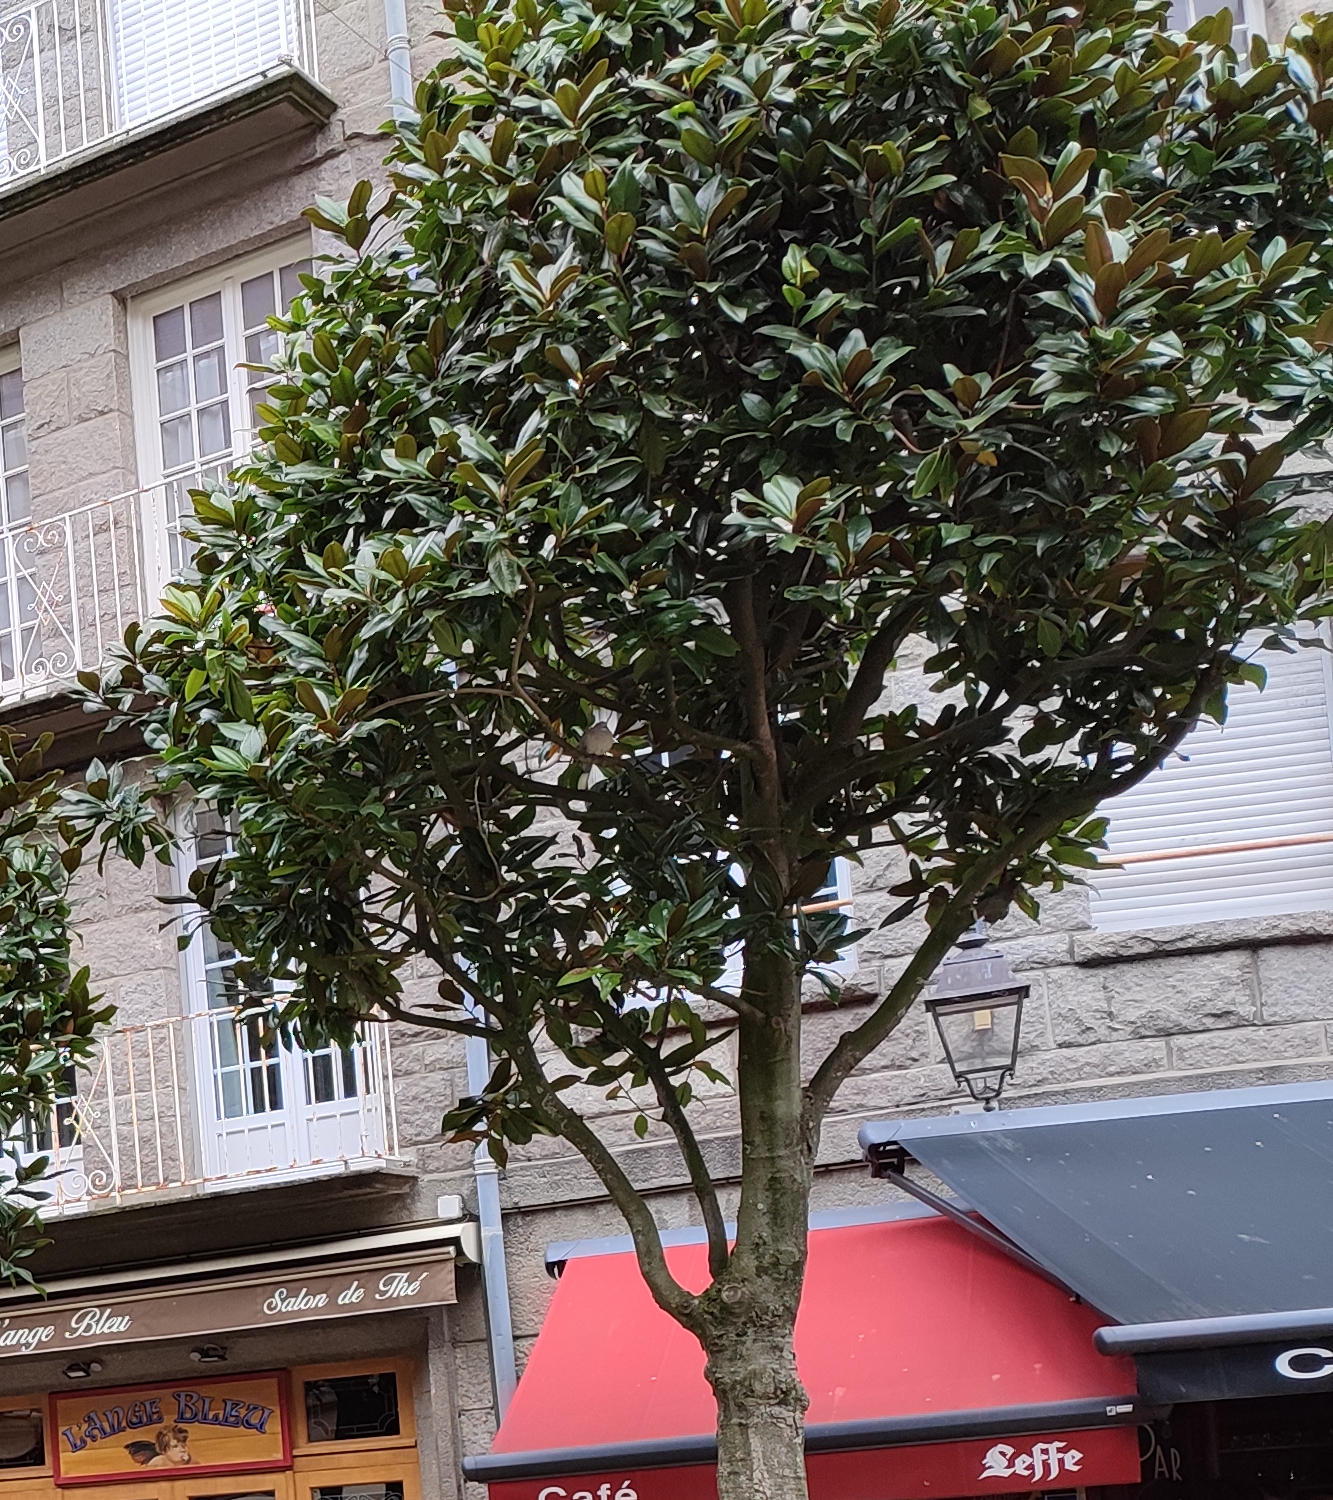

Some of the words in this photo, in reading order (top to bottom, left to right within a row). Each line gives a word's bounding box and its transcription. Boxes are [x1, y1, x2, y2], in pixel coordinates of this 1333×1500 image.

[263, 1287, 329, 1315] Salon
[337, 1280, 365, 1305] de
[374, 1271, 429, 1300] Thé
[65, 1307, 133, 1339] Bleu
[172, 1390, 273, 1435] BLEU
[977, 1441, 1084, 1483] Leffe
